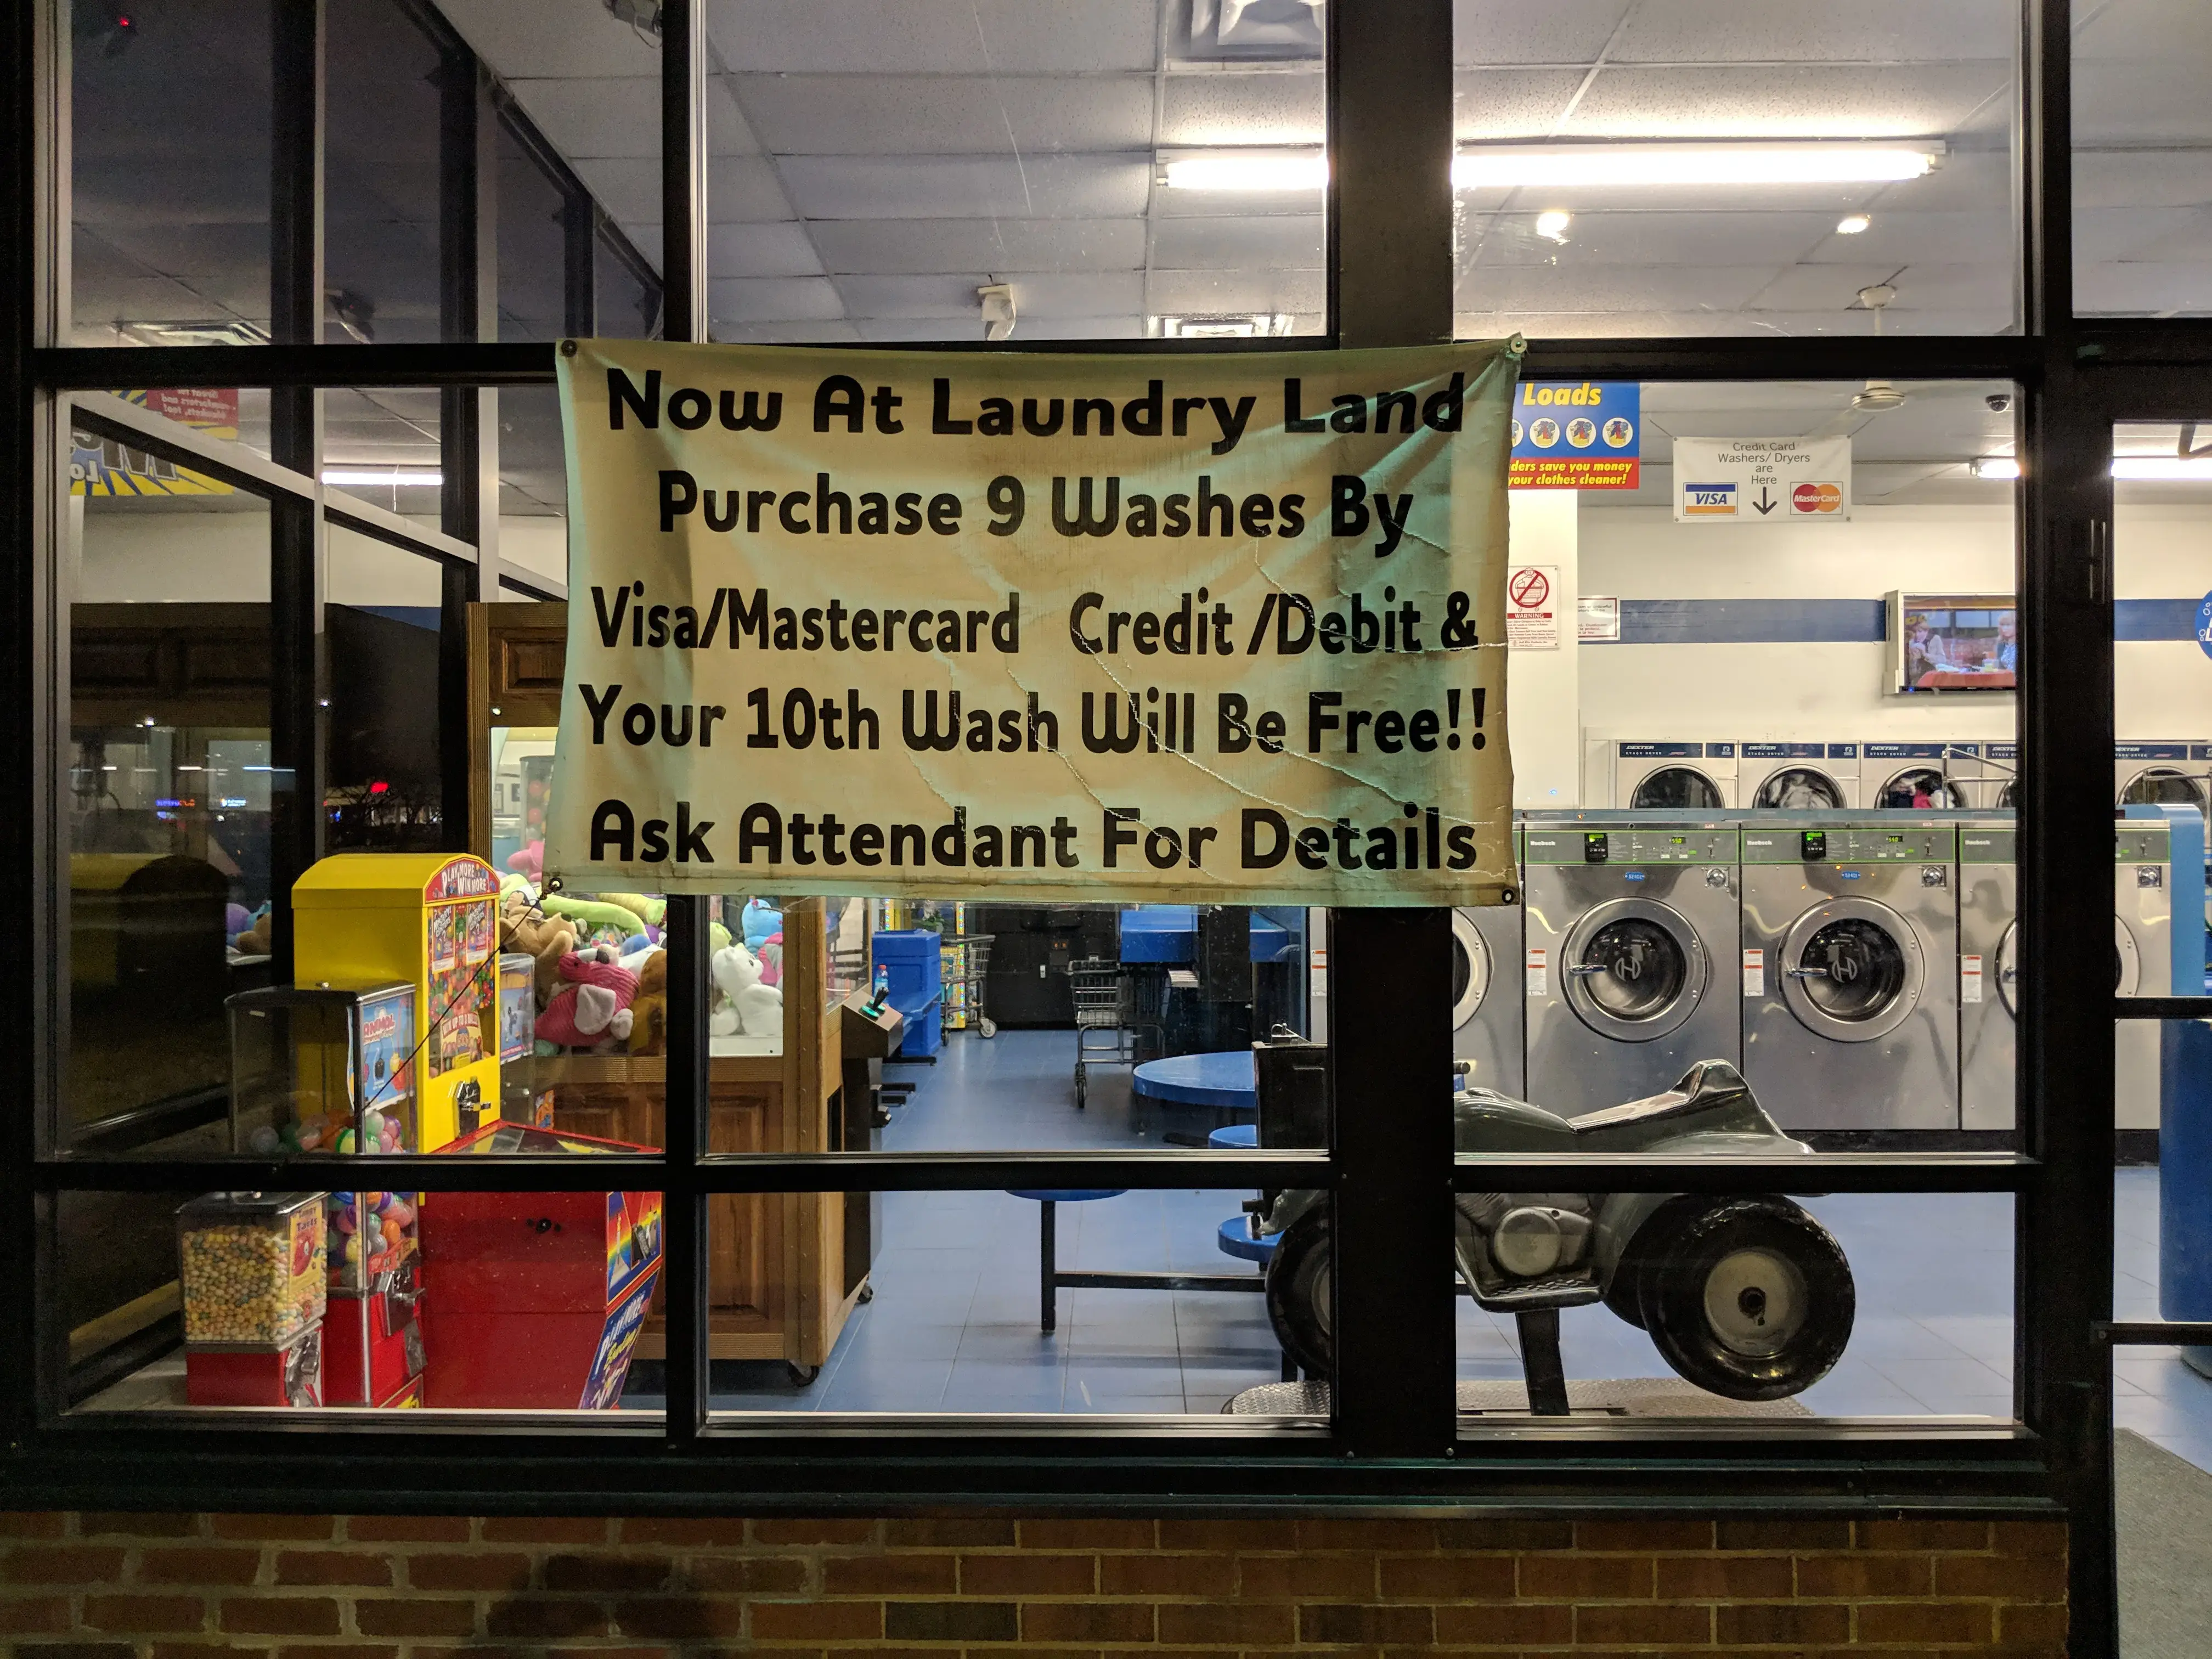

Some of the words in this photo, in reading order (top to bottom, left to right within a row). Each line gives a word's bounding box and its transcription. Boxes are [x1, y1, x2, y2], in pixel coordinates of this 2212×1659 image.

[1523, 382, 1602, 405] Loads
[607, 368, 783, 432] Now
[814, 375, 905, 435] At
[932, 377, 1257, 455] Laundry
[1284, 371, 1465, 435] Land
[1733, 442, 1767, 451] Credit
[1770, 442, 1796, 451] Card
[1718, 453, 1771, 463] Washers/
[1775, 453, 1810, 464] Dryers
[1539, 463, 1566, 472] save
[1569, 463, 1590, 473] you
[1593, 463, 1633, 473] money
[1755, 465, 1774, 473] are
[1536, 473, 1577, 485] clothes
[1579, 473, 1628, 485] cleaner!
[1751, 475, 1778, 484] Here
[1694, 493, 1728, 505] VISA
[1793, 494, 1840, 504] MasterCard
[658, 470, 963, 535] Purchase
[987, 475, 1026, 537] 9
[1052, 475, 1306, 538] Washes
[1331, 475, 1414, 558] By
[591, 580, 1019, 653] Visa/Mastercard
[1069, 586, 1233, 656] Credit
[1440, 591, 1479, 651] &
[579, 684, 726, 747] Your
[747, 687, 879, 749] 10th
[902, 690, 1059, 753] Wash
[1081, 687, 1194, 754] Will
[1218, 693, 1286, 754] Be
[1308, 687, 1486, 754] Free!!
[590, 799, 715, 863] Ask
[739, 802, 1077, 868] Attendant
[1103, 808, 1217, 869] For
[1241, 803, 1477, 871] Details
[441, 864, 458, 897] PLAY
[459, 862, 475, 878] MORE
[458, 877, 471, 897] WIN
